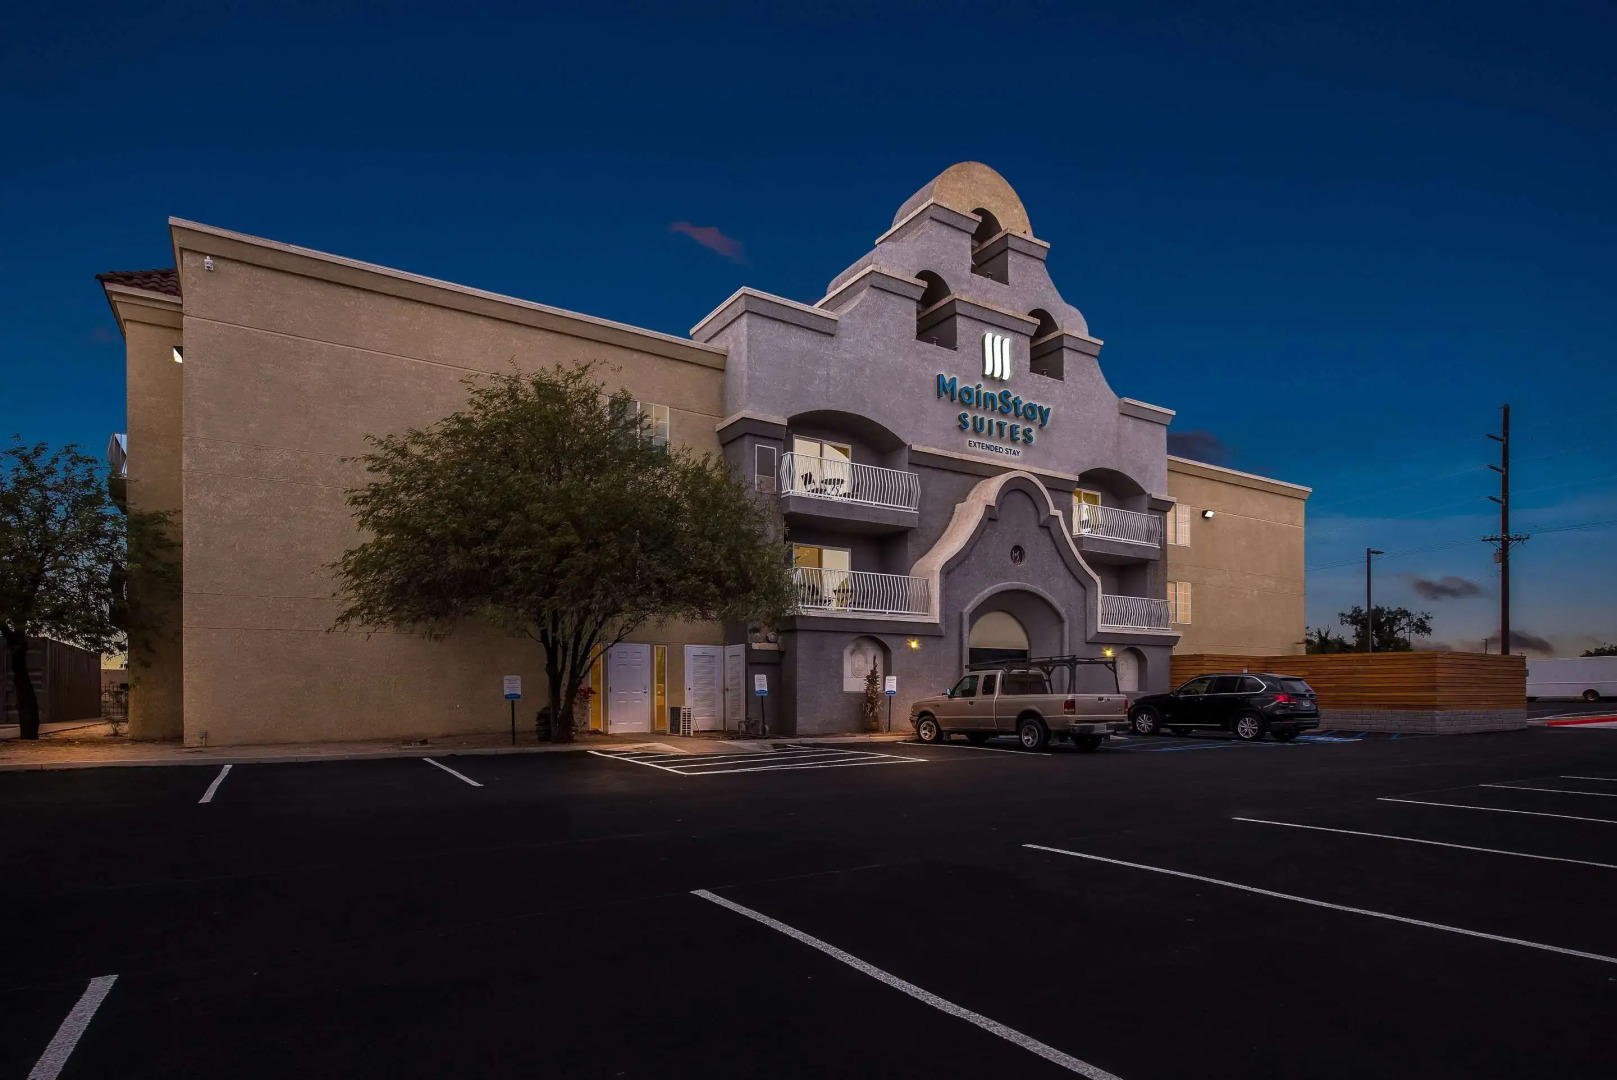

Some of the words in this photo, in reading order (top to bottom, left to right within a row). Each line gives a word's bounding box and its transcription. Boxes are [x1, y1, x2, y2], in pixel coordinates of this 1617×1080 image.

[937, 373, 1051, 428] MainStay
[958, 412, 1034, 444] SUITES
[968, 440, 1004, 454] EXTENDED
[1004, 447, 1021, 457] STAY
